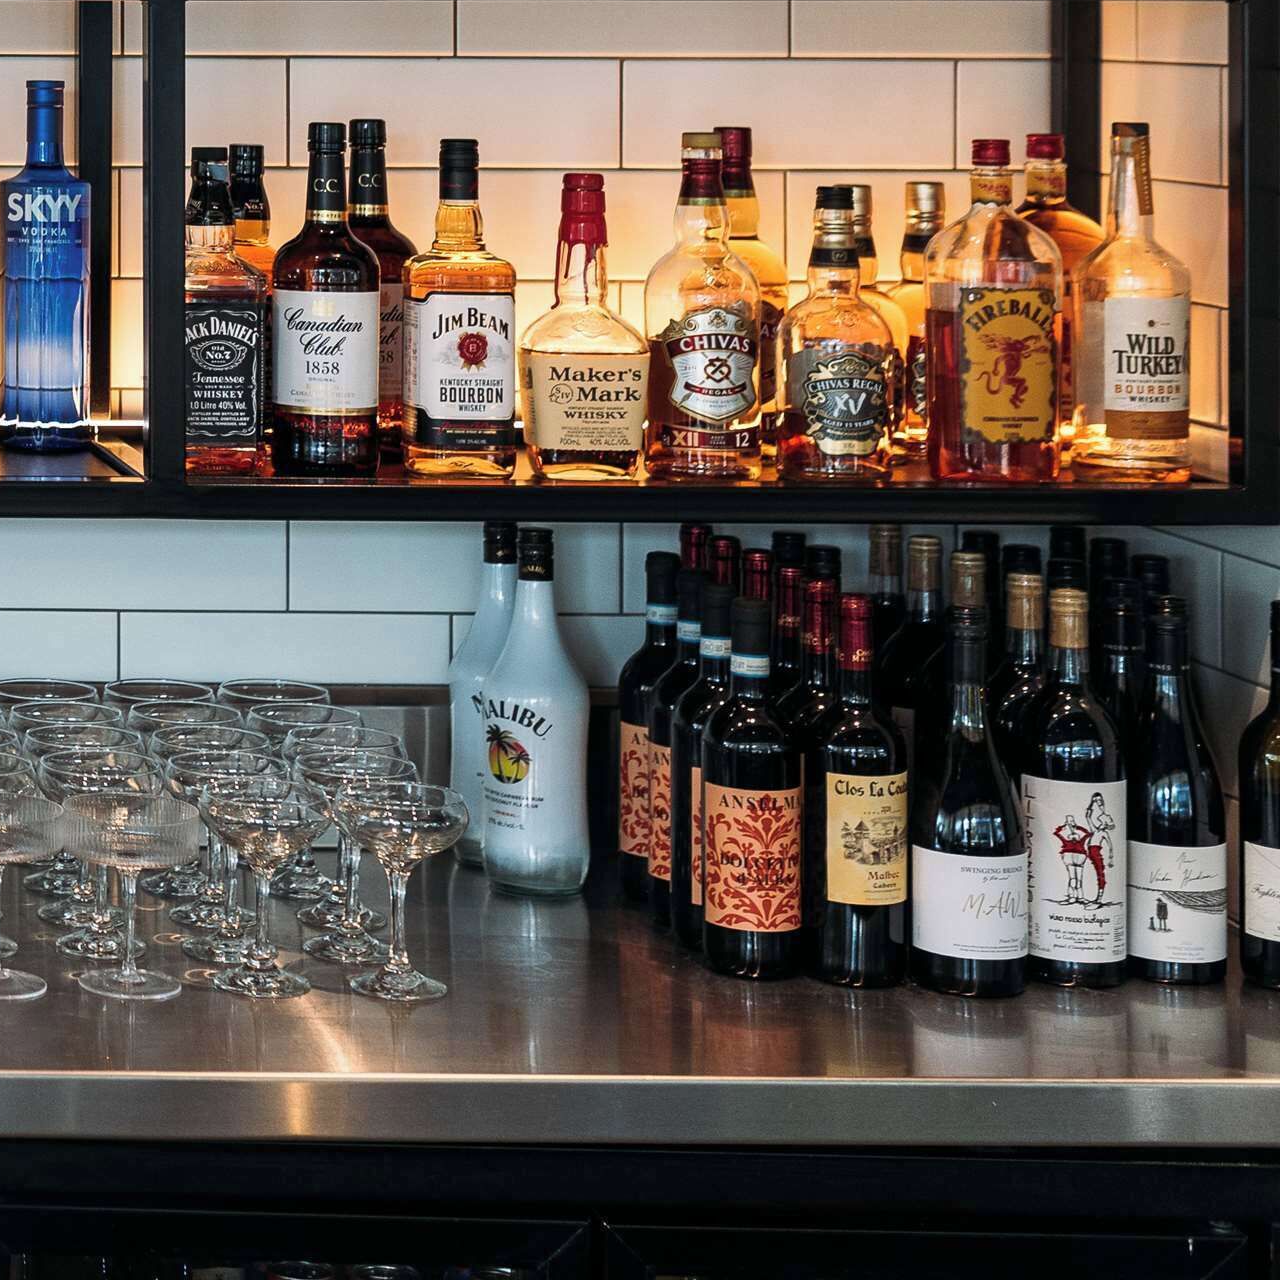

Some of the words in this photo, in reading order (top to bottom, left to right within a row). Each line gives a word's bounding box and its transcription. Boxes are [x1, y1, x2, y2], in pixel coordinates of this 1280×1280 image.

[7, 192, 82, 222] SKYY
[21, 226, 68, 237] VODKA
[283, 307, 363, 333] Canadian
[965, 296, 1054, 333] FIREBALL
[210, 318, 260, 345] DANIEL'S
[432, 311, 463, 340] JIM
[467, 307, 509, 340] BEAM
[299, 334, 342, 356] Club
[679, 334, 751, 353] CHIVAS
[1126, 332, 1174, 356] WILD
[305, 360, 340, 375] 1858
[1112, 349, 1182, 378] TURKEY
[192, 372, 245, 385] Tennessee
[547, 366, 642, 382] Maker's
[193, 390, 244, 399] WHISKEY
[576, 385, 639, 402] Mark
[701, 388, 733, 397] REGAL
[808, 378, 850, 394] CHIVAS
[851, 378, 884, 394] REGAL
[1114, 383, 1181, 395] BOURBON
[440, 386, 504, 404] BOURBON
[1128, 395, 1173, 404] WHISKEY
[201, 401, 217, 410] Litre
[458, 404, 487, 412] WHISKEY
[833, 392, 864, 418] XV
[563, 411, 629, 420] WHISKY
[673, 430, 699, 448] XII
[735, 432, 750, 448] 12
[834, 780, 865, 797] Clos
[868, 780, 884, 797] La
